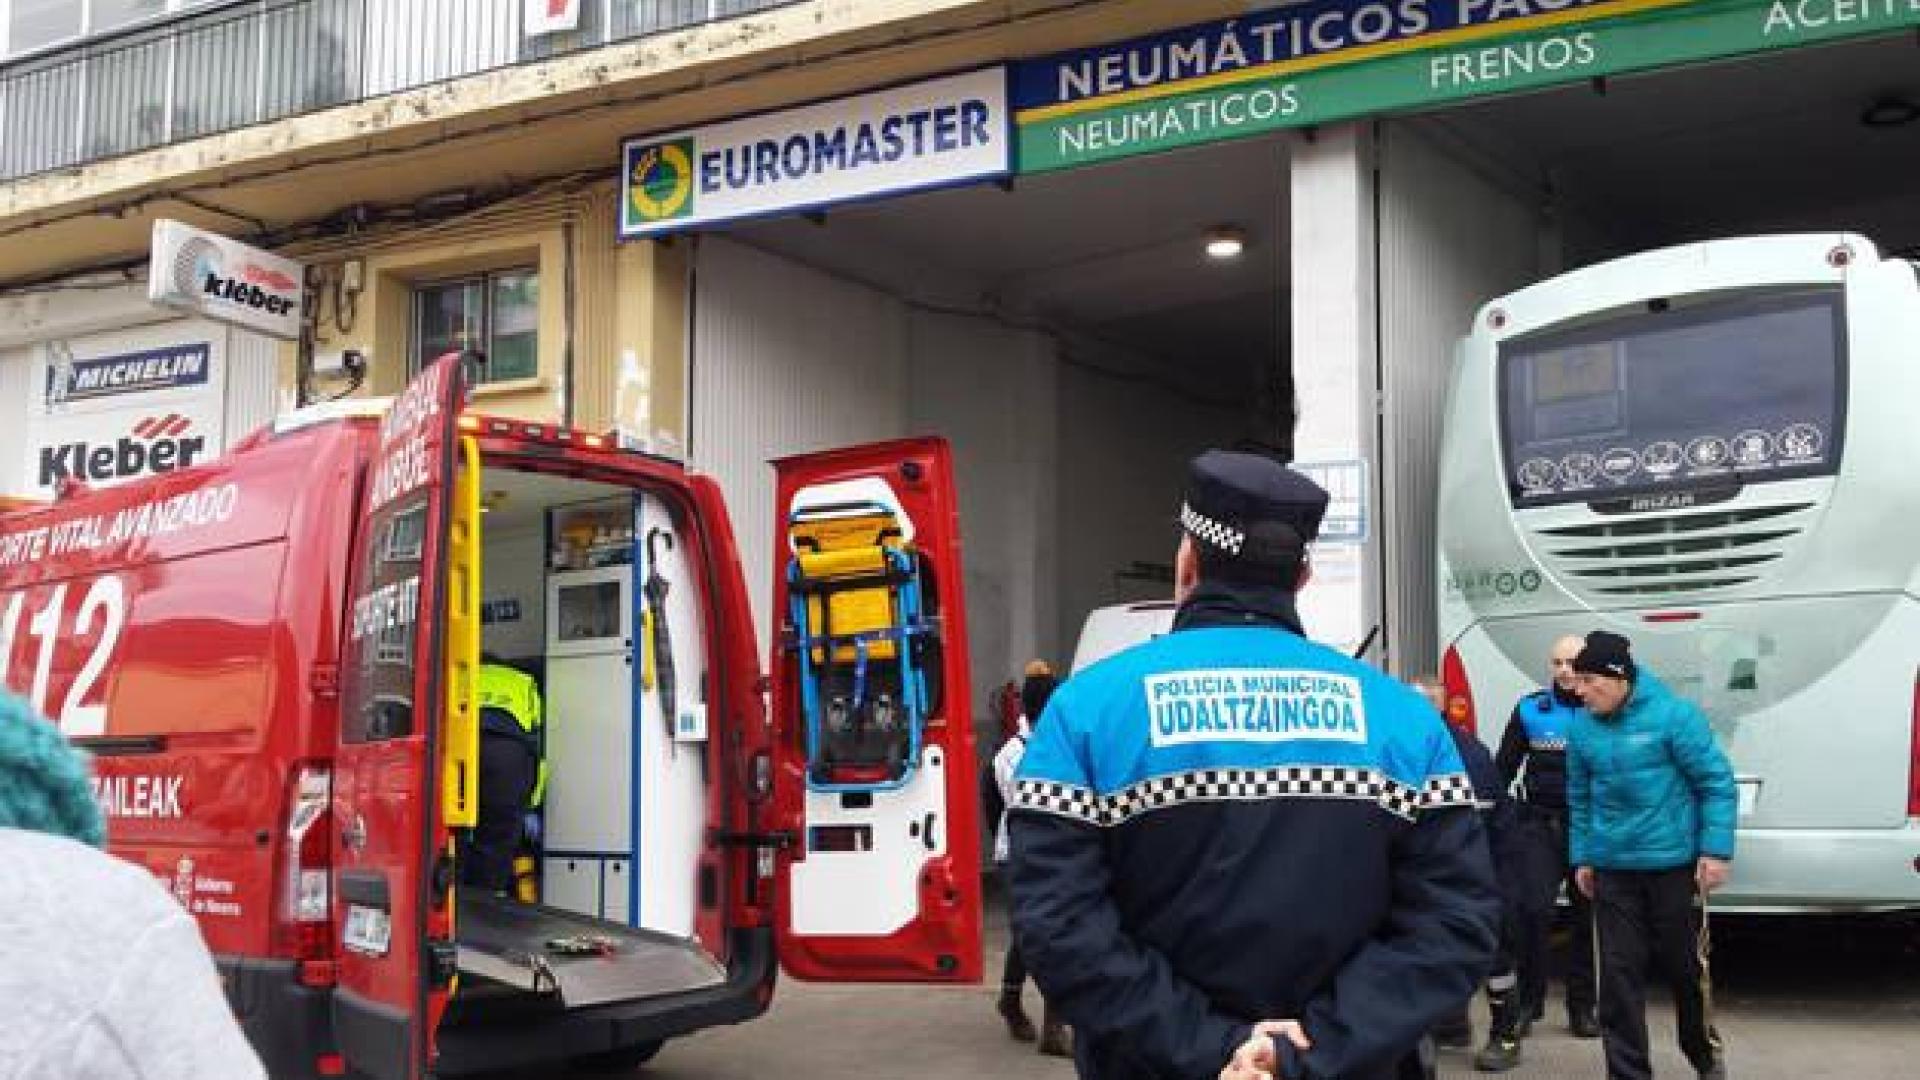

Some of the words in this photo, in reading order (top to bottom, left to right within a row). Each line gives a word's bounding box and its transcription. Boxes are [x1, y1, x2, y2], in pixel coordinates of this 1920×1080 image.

[1058, 0, 1430, 102] NEUMÁTICOS
[1431, 32, 1596, 89] FRENOS
[700, 98, 991, 196] EUROMASTER
[1058, 84, 1299, 155] NEUMATICOS
[75, 350, 203, 389] MICHELIN
[1153, 675, 1237, 700] POLICIA
[1241, 676, 1356, 700] MUNICIPAL
[1156, 697, 1359, 735] UDALTZAINGOA
